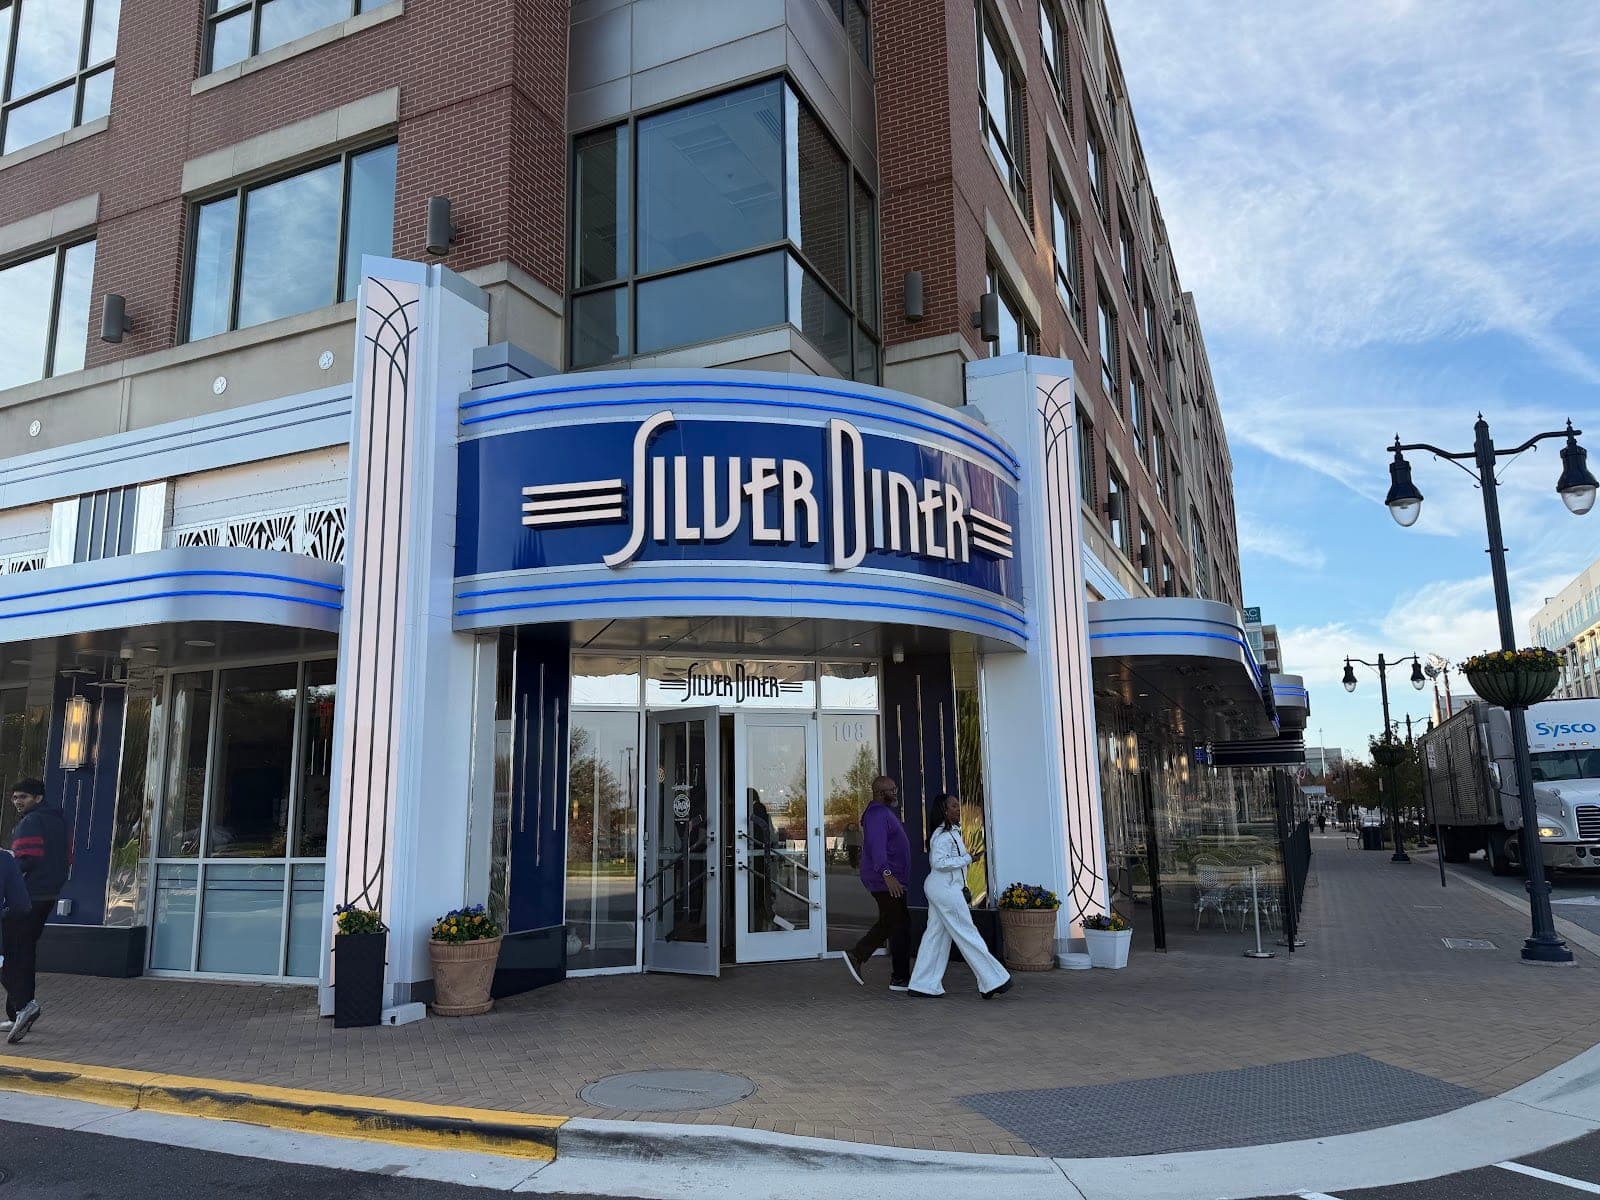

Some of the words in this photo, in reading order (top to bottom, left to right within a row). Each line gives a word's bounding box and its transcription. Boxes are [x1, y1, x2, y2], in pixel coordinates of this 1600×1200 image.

[602, 410, 819, 570] SILVER
[829, 418, 970, 572] DINER
[681, 662, 733, 702] SILVER
[735, 663, 779, 703] DINER
[832, 721, 864, 742] 108
